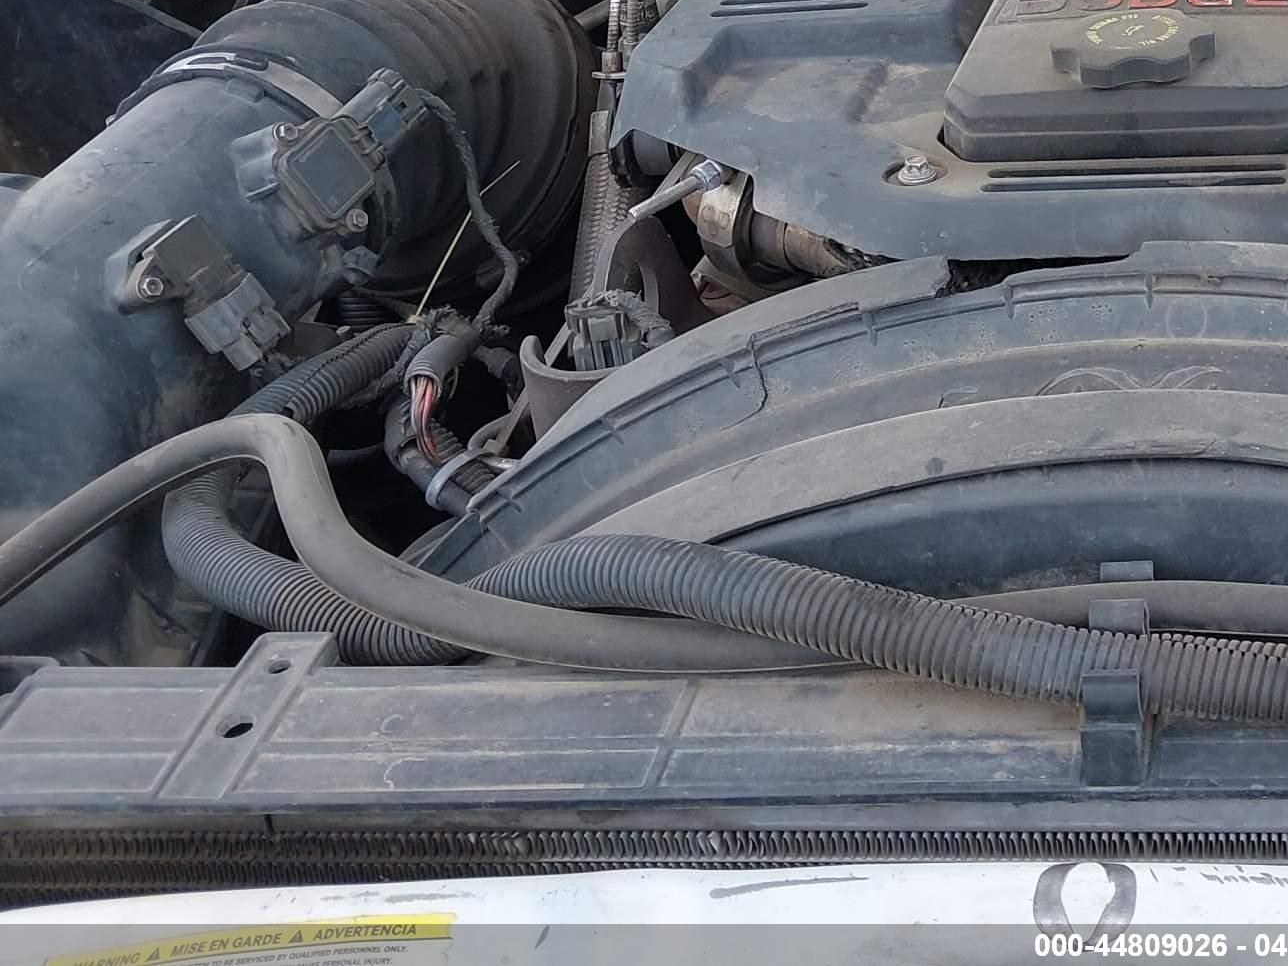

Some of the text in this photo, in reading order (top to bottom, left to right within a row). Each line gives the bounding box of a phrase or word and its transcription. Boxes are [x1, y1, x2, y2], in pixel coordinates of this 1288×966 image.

[169, 941, 208, 957] MISE
[208, 938, 229, 952] EN
[232, 933, 283, 948] GARDE
[313, 924, 417, 941] ADVERTENCIA
[277, 953, 287, 961] BY
[288, 949, 333, 960] QUALIFIED
[333, 947, 383, 956] PERSONNEL
[384, 945, 409, 953] ONLY.
[363, 956, 393, 965] INJURY.
